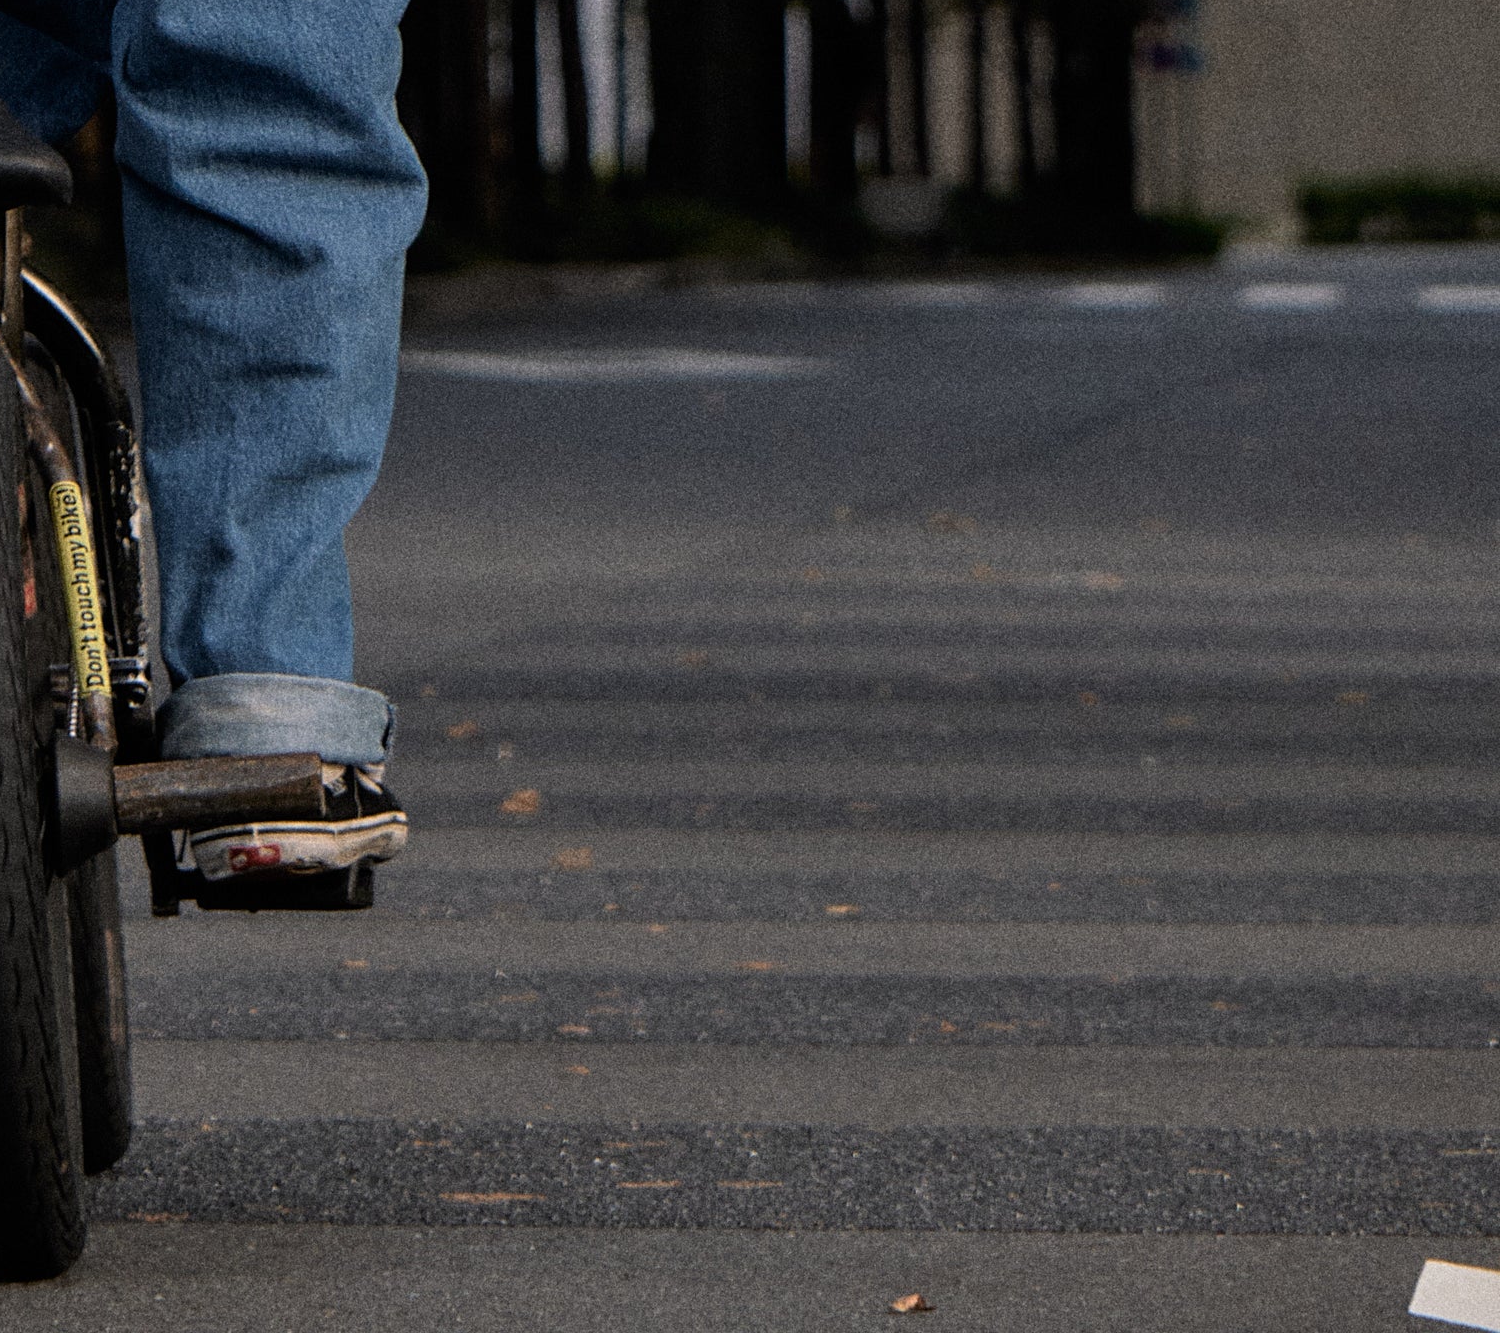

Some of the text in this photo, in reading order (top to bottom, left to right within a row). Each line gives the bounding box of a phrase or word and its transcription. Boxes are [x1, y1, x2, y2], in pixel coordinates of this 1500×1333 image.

[56, 488, 105, 688] Don't touch my bike!
